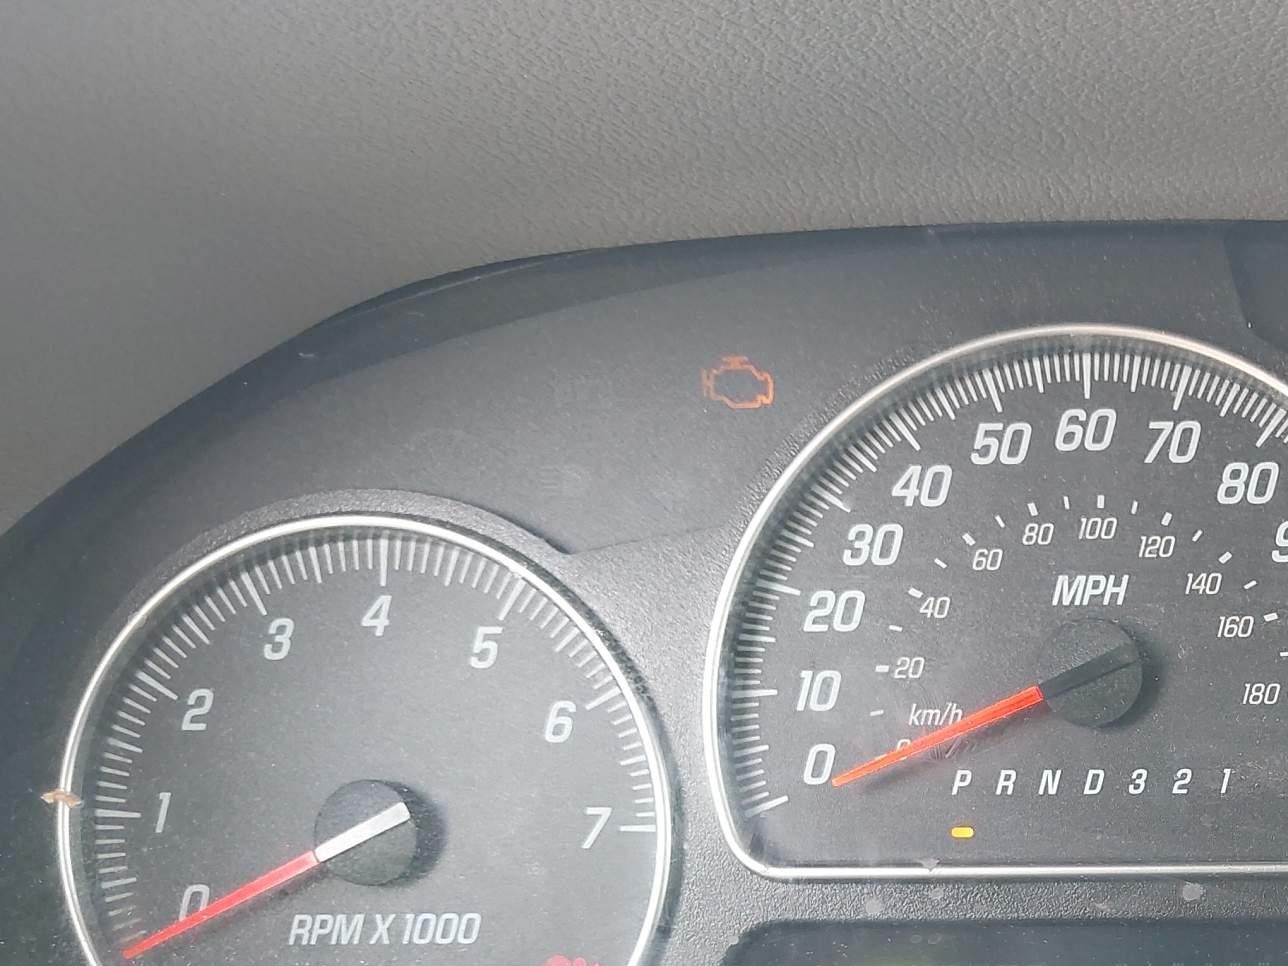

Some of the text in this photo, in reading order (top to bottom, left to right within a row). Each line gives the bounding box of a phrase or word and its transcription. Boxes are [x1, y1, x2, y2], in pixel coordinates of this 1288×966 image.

[971, 422, 1032, 465] 50
[1055, 409, 1116, 451] 60
[1146, 421, 1201, 463] 70
[892, 464, 952, 507] 40
[1217, 462, 1279, 504] 80
[843, 524, 903, 565] 30
[1022, 523, 1054, 545] 80
[1079, 517, 1117, 539] 100
[1139, 536, 1175, 557] 120
[973, 549, 1003, 570] 60
[1052, 575, 1129, 605] MPH
[1185, 573, 1222, 594] 140
[361, 595, 392, 636] 4
[803, 590, 865, 632] 20
[919, 597, 950, 618] 40
[1218, 616, 1254, 637] 160
[264, 618, 294, 660] 3
[469, 627, 502, 668] 5
[893, 657, 924, 678] 20
[182, 689, 213, 730] 2
[796, 670, 841, 711] 10
[1243, 684, 1280, 704] 180
[544, 700, 576, 743] 6
[909, 703, 963, 726] km/h
[801, 744, 835, 785] 0
[952, 769, 1231, 795] P R N D 3 2 1
[156, 792, 171, 833] 1
[583, 807, 611, 848] 7
[289, 913, 481, 945] RPM X 1000
